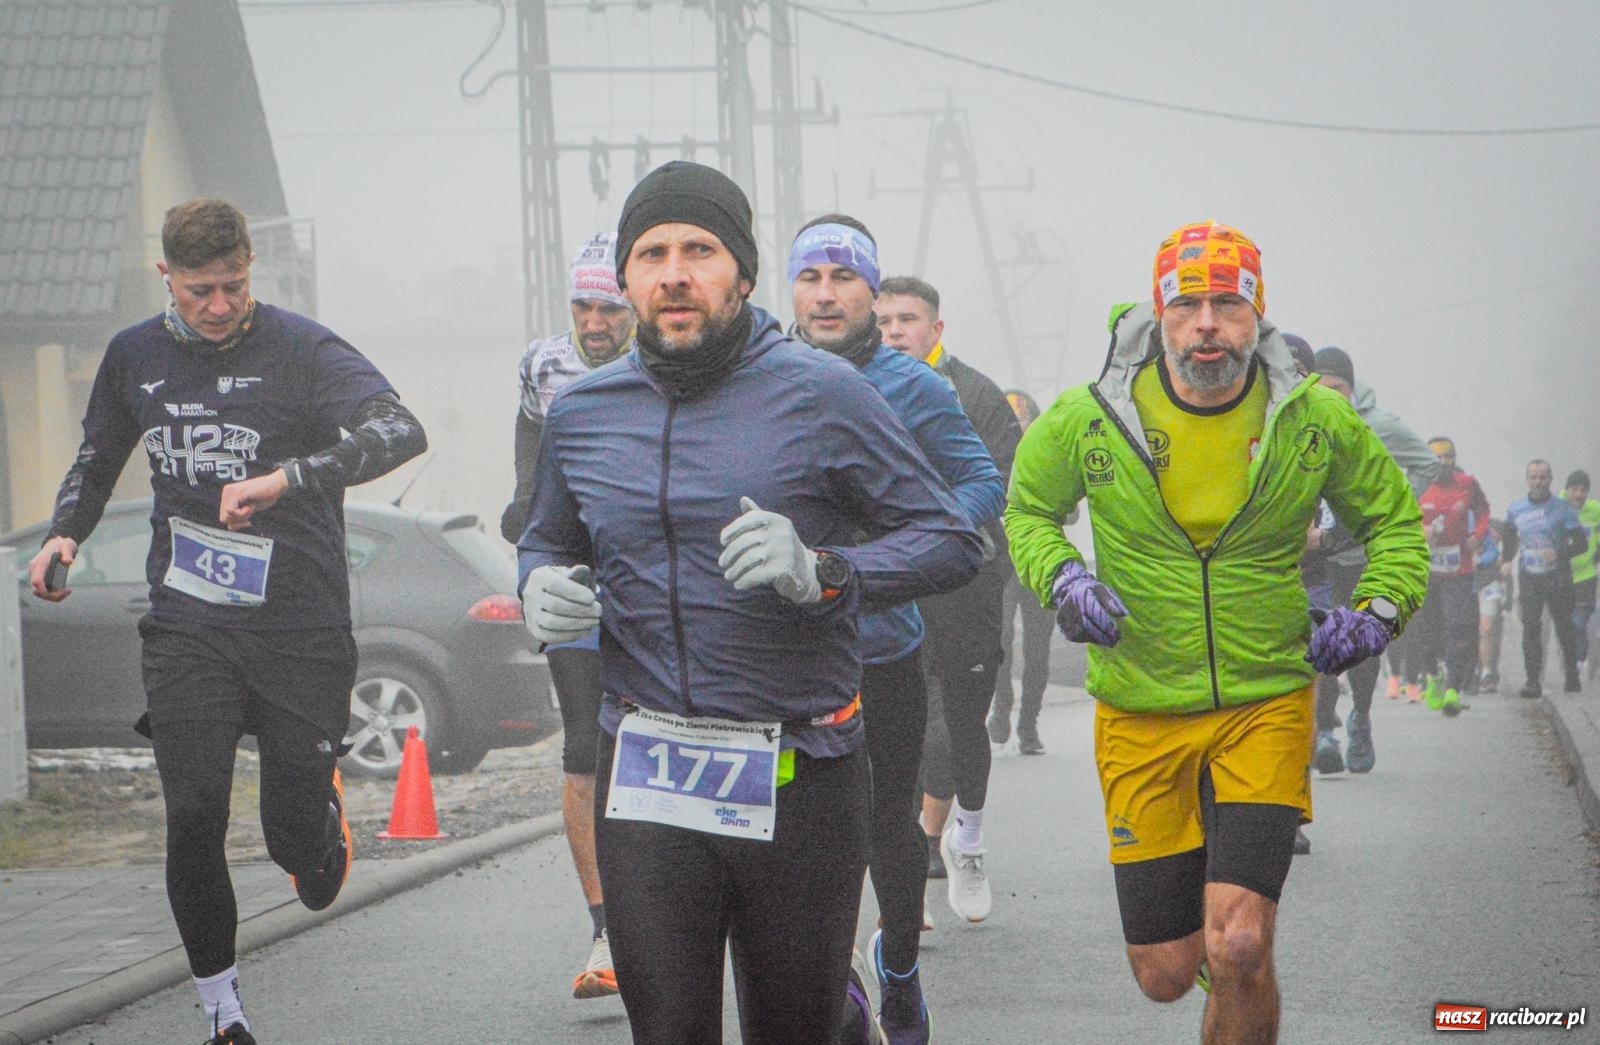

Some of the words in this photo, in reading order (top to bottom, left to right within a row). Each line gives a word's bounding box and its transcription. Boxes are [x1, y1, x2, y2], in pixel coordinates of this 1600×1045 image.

[180, 409, 219, 417] MARATHON
[215, 459, 247, 481] 50
[195, 548, 237, 586] 43
[653, 714, 674, 726] Cross
[674, 720, 685, 729] po
[685, 721, 709, 731] Ziemi
[646, 742, 748, 799] 177
